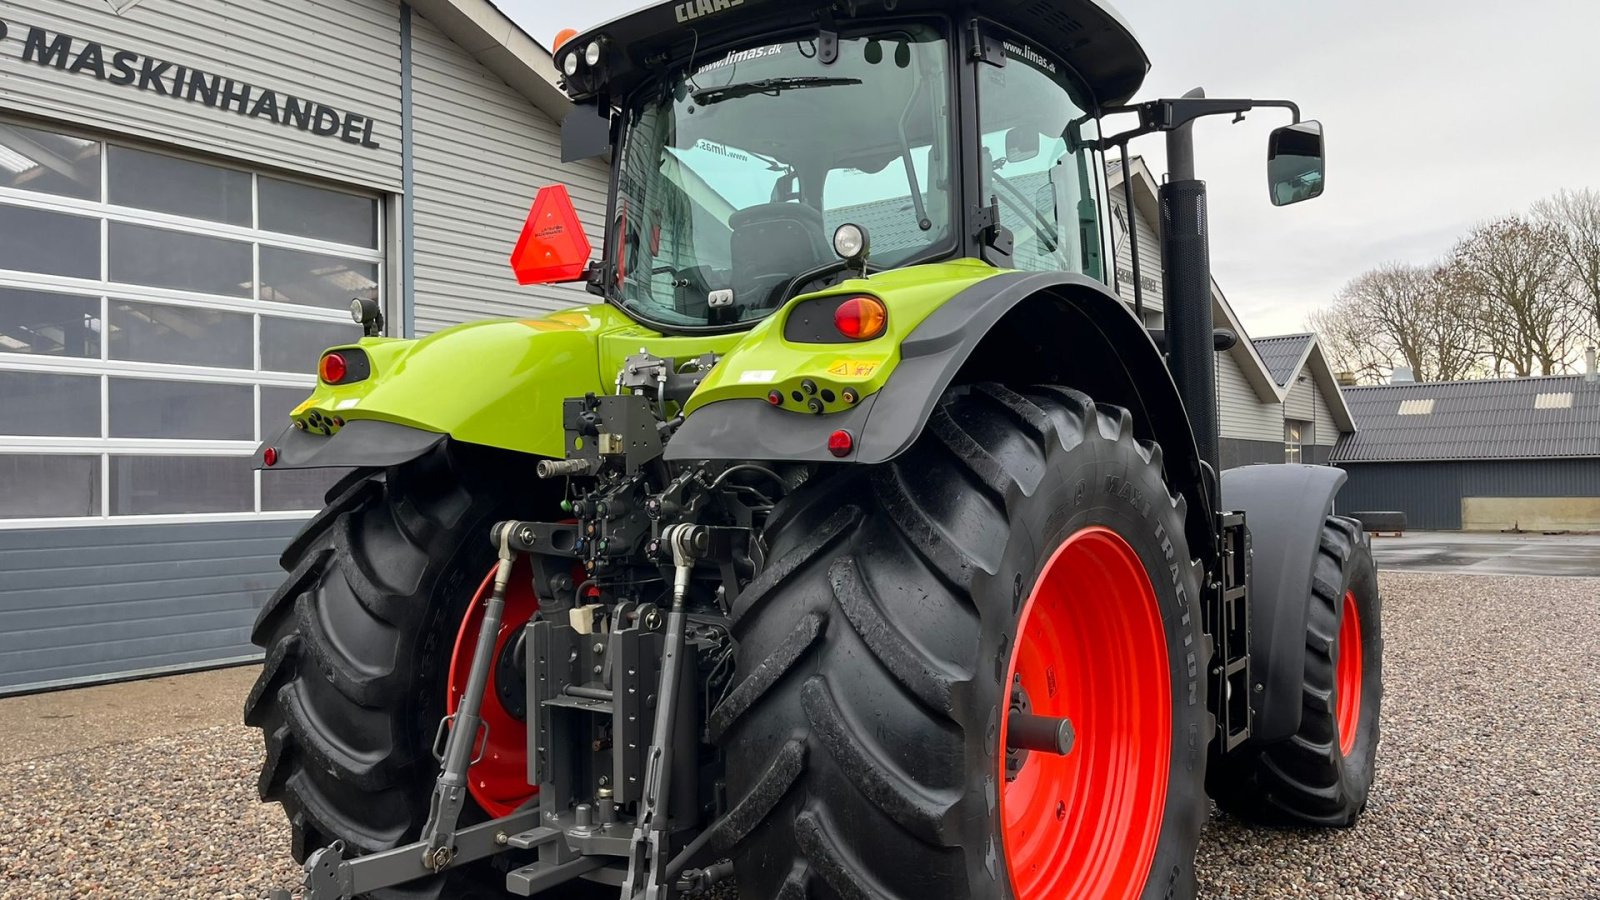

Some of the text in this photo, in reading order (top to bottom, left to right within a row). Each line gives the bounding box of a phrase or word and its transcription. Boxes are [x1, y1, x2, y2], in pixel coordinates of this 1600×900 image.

[21, 26, 380, 149] MASKINHANDEL
[697, 44, 783, 75] www.limas.dk
[1002, 41, 1056, 74] www.limas.dk
[1104, 474, 1150, 519] MAXI
[1153, 518, 1198, 706] TRACTION
